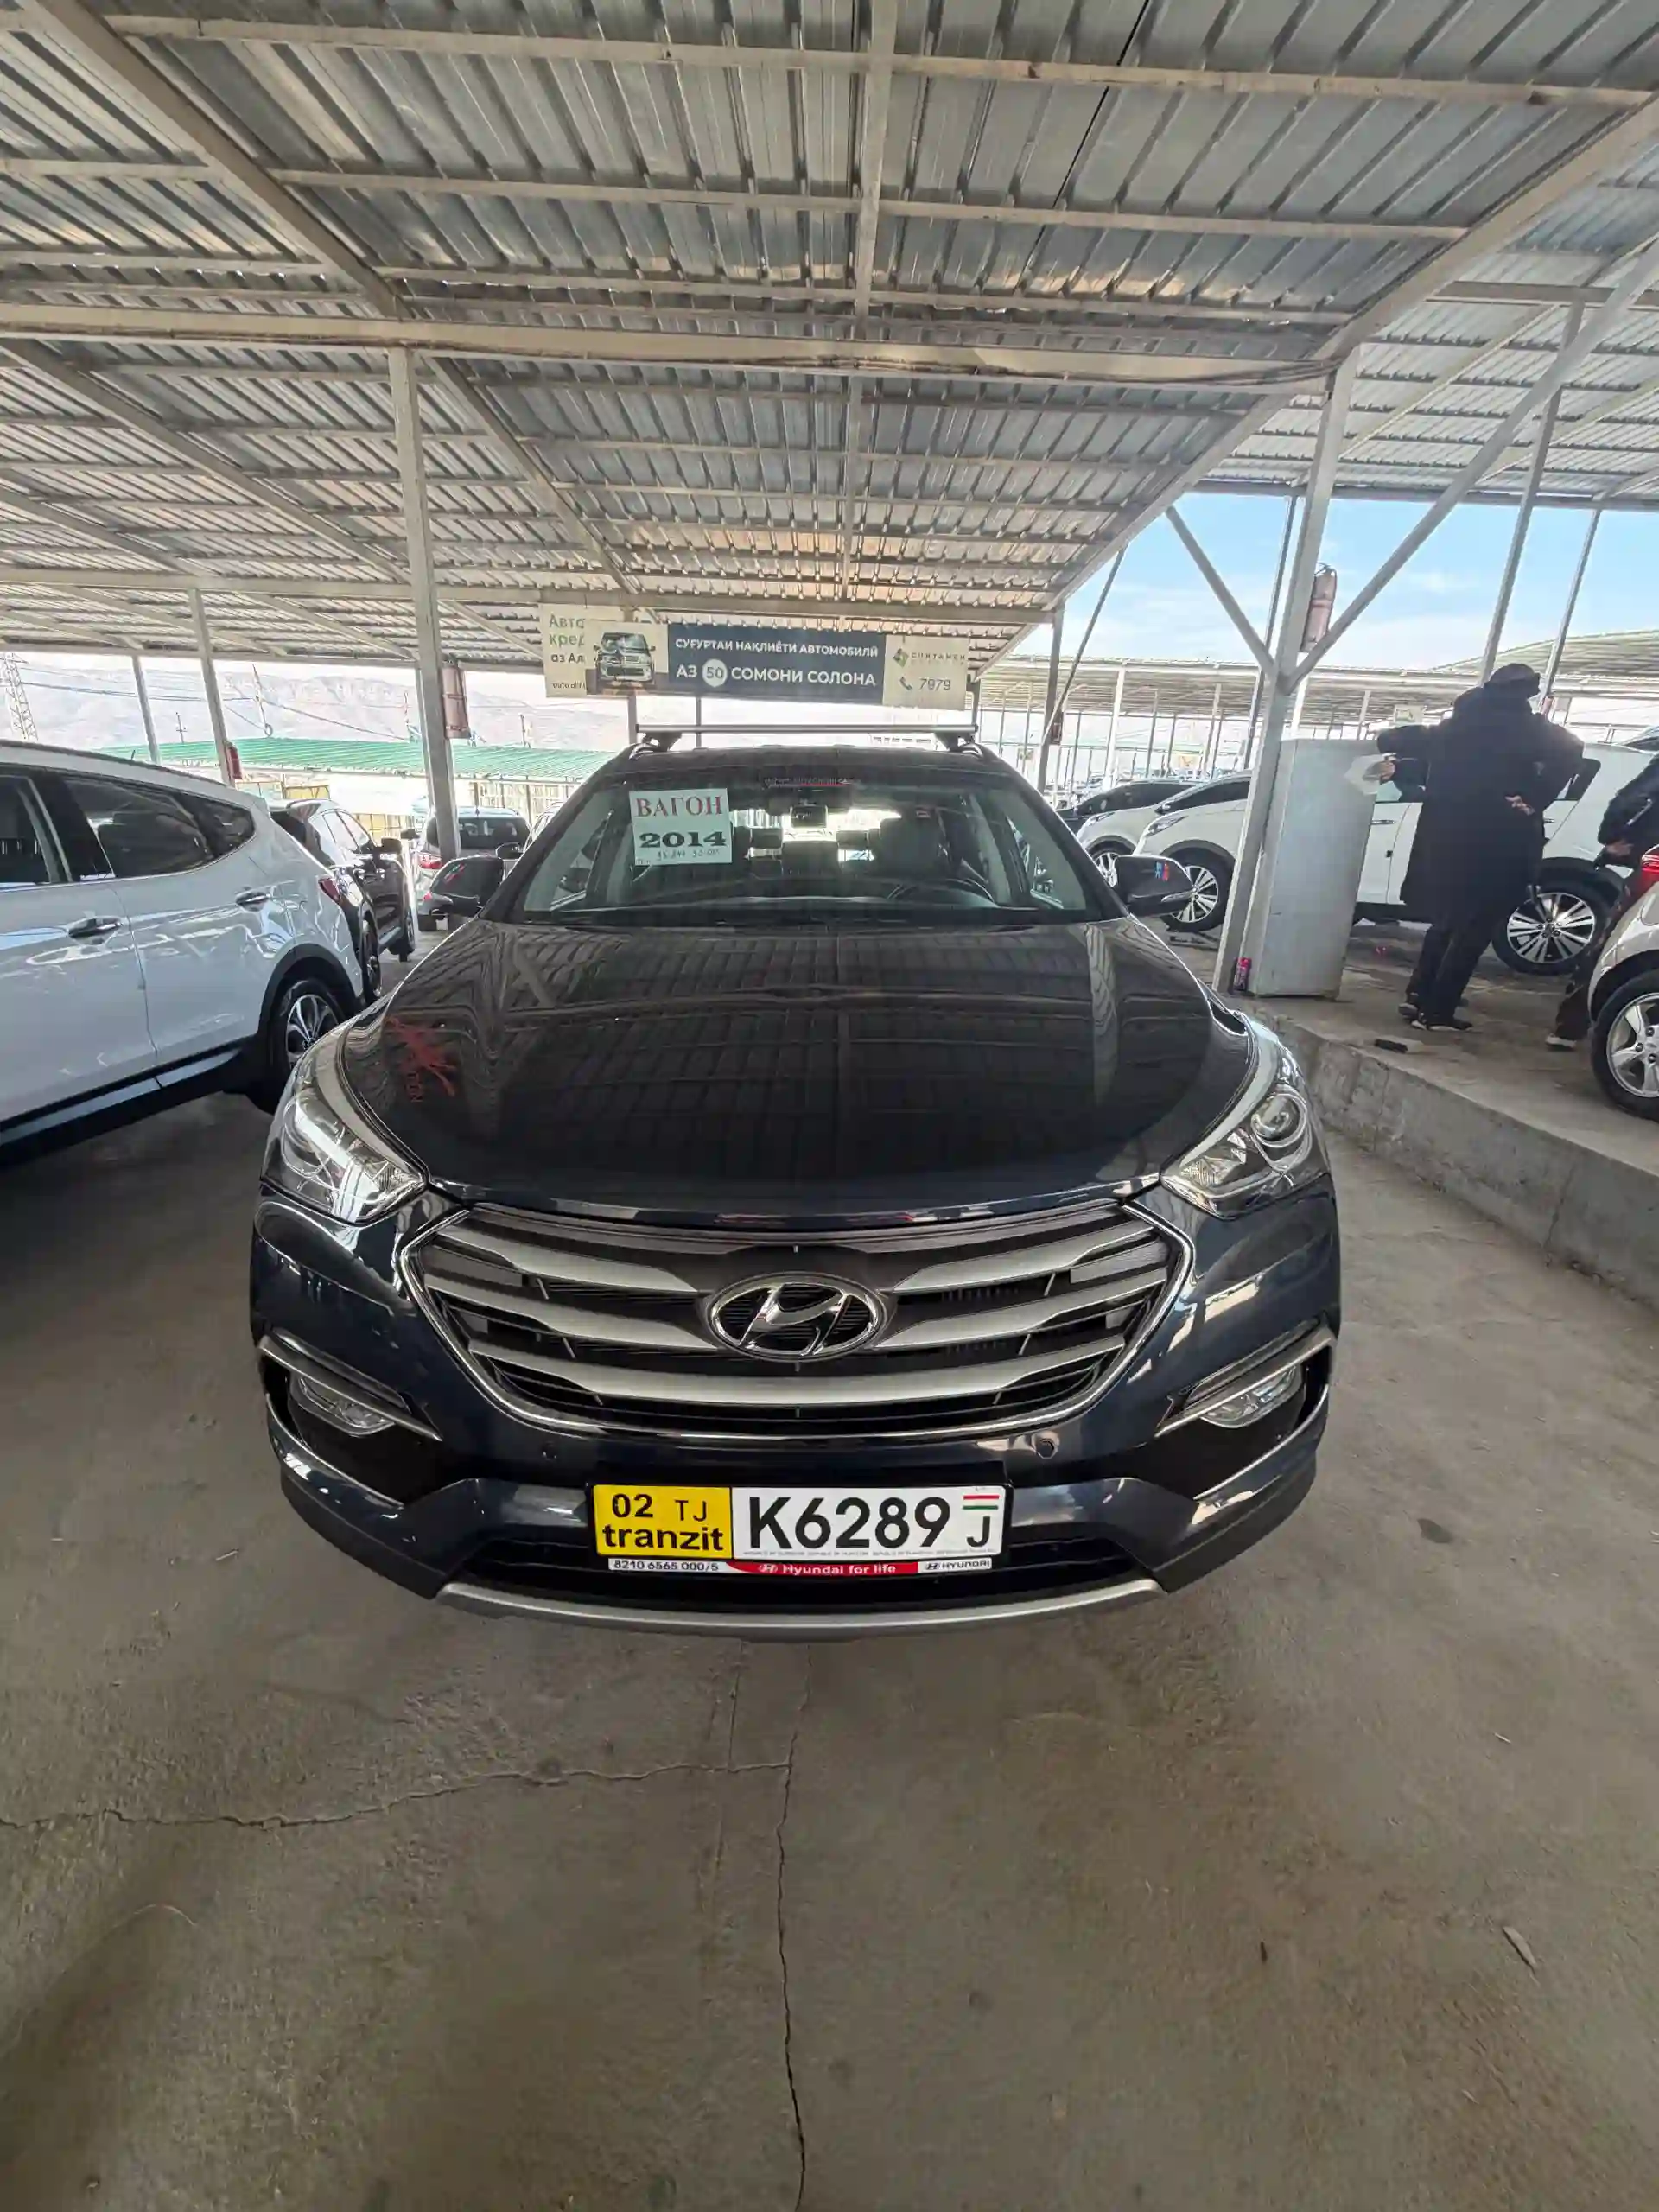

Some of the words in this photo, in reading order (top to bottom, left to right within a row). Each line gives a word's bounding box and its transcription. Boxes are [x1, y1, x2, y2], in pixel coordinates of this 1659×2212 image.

[676, 664, 698, 678] АЗ
[705, 666, 725, 679] 50
[731, 666, 804, 683] СОМОНИ
[807, 671, 877, 687] СОЛОНА
[634, 795, 723, 817] ВАГОН
[639, 831, 728, 849] 2014
[611, 1493, 654, 1518] 02
[674, 1499, 708, 1522] TJ
[749, 1496, 951, 1549] K6289
[966, 1516, 991, 1548] J
[602, 1523, 724, 1551] tranzit
[613, 1560, 645, 1570] 8210
[647, 1560, 678, 1571] 6565
[783, 1563, 844, 1576] Hyundai
[849, 1564, 870, 1575] for
[874, 1563, 897, 1574] life
